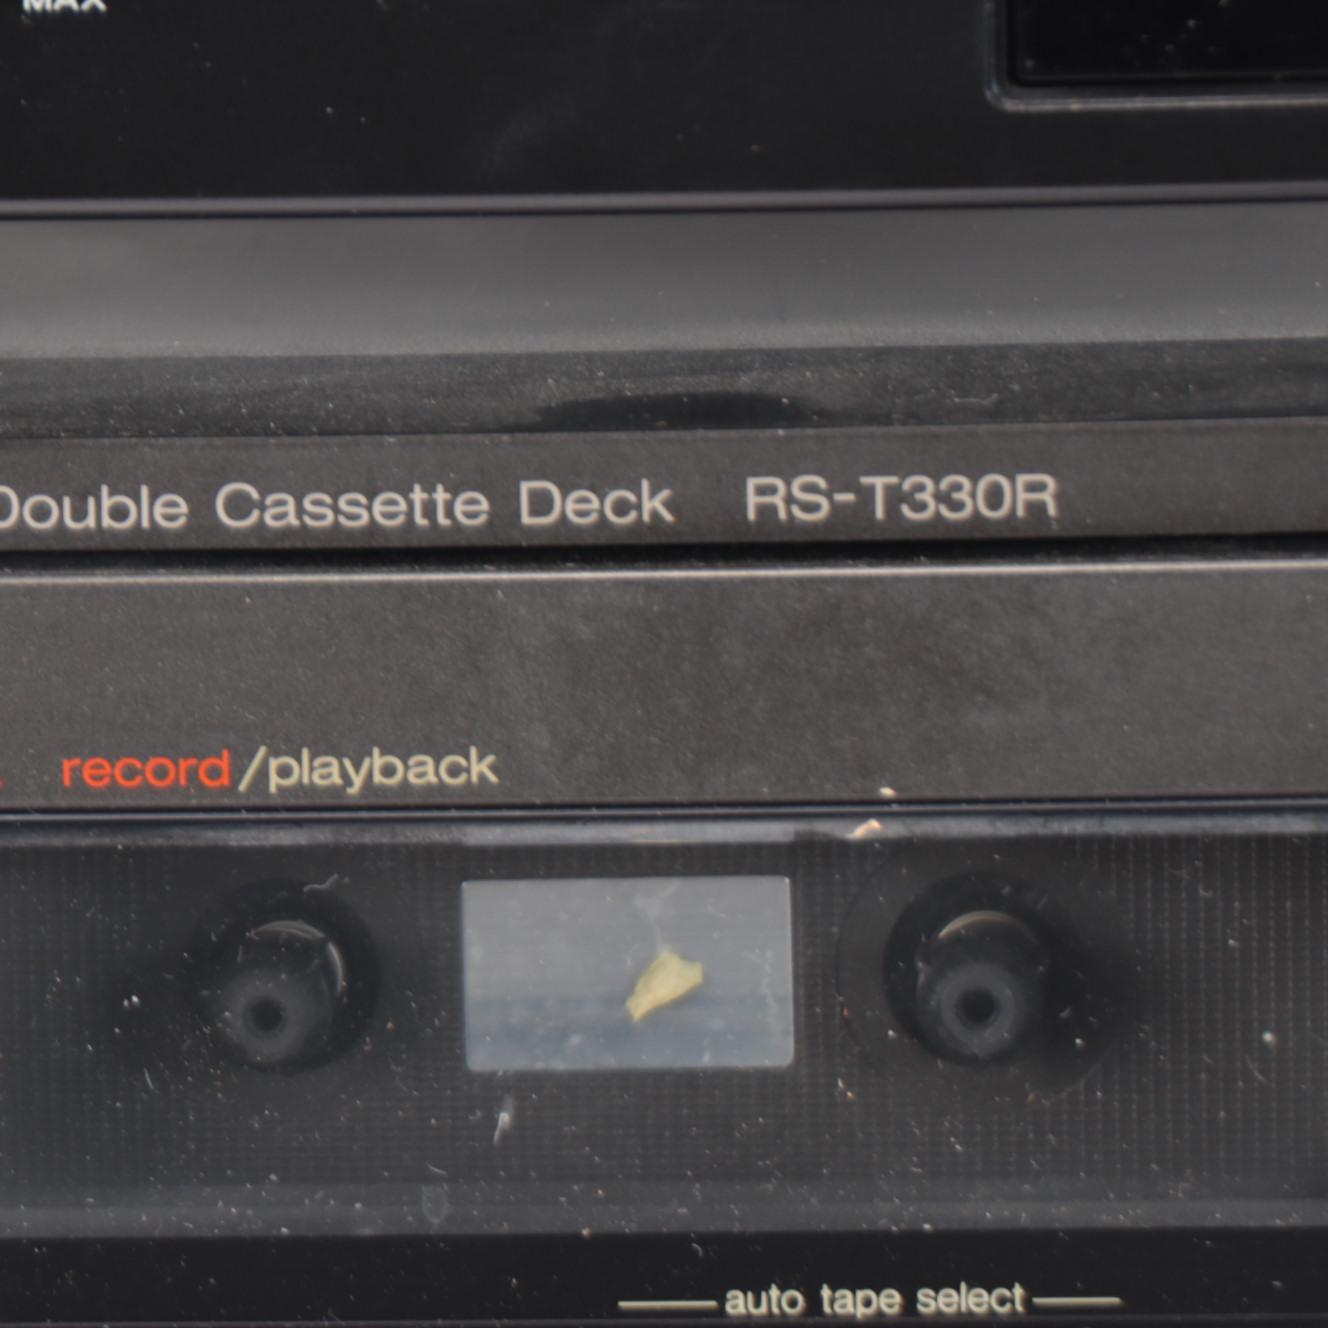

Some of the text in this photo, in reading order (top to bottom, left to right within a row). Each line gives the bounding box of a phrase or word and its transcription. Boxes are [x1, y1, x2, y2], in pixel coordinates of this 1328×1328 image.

[215, 482, 490, 529] Cassette
[519, 478, 675, 526] Deck
[746, 473, 1057, 522] RS-T330R
[725, 1282, 1024, 1319] auto tape select
